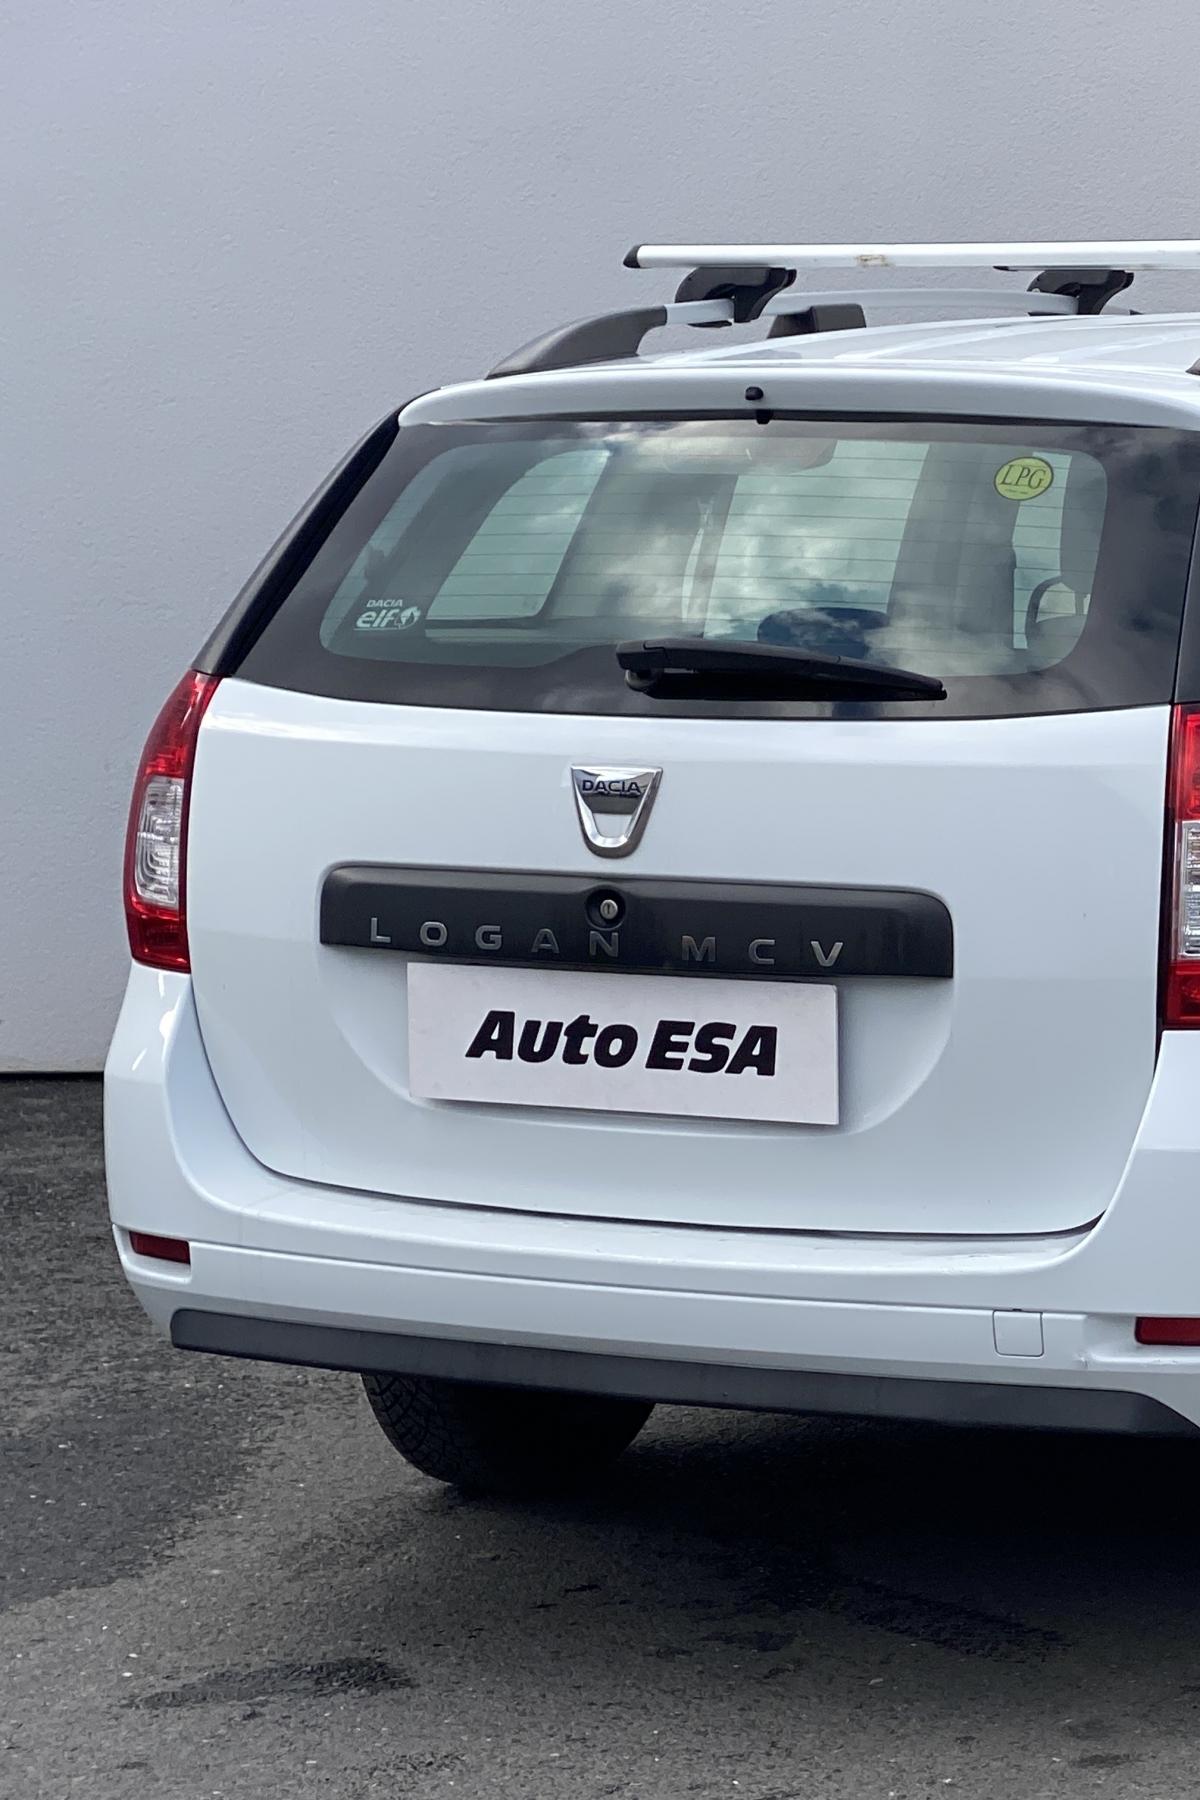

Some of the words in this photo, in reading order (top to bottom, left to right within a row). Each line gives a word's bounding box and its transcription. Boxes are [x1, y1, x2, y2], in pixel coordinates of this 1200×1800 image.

[1000, 464, 1046, 490] LPG
[366, 599, 403, 608] DACIA
[355, 608, 400, 628] elf
[581, 779, 641, 793] DACIA
[370, 917, 619, 957] LOGAN
[681, 934, 844, 967] MCV
[464, 1009, 639, 1069] Auto
[644, 1019, 778, 1077] ESA
